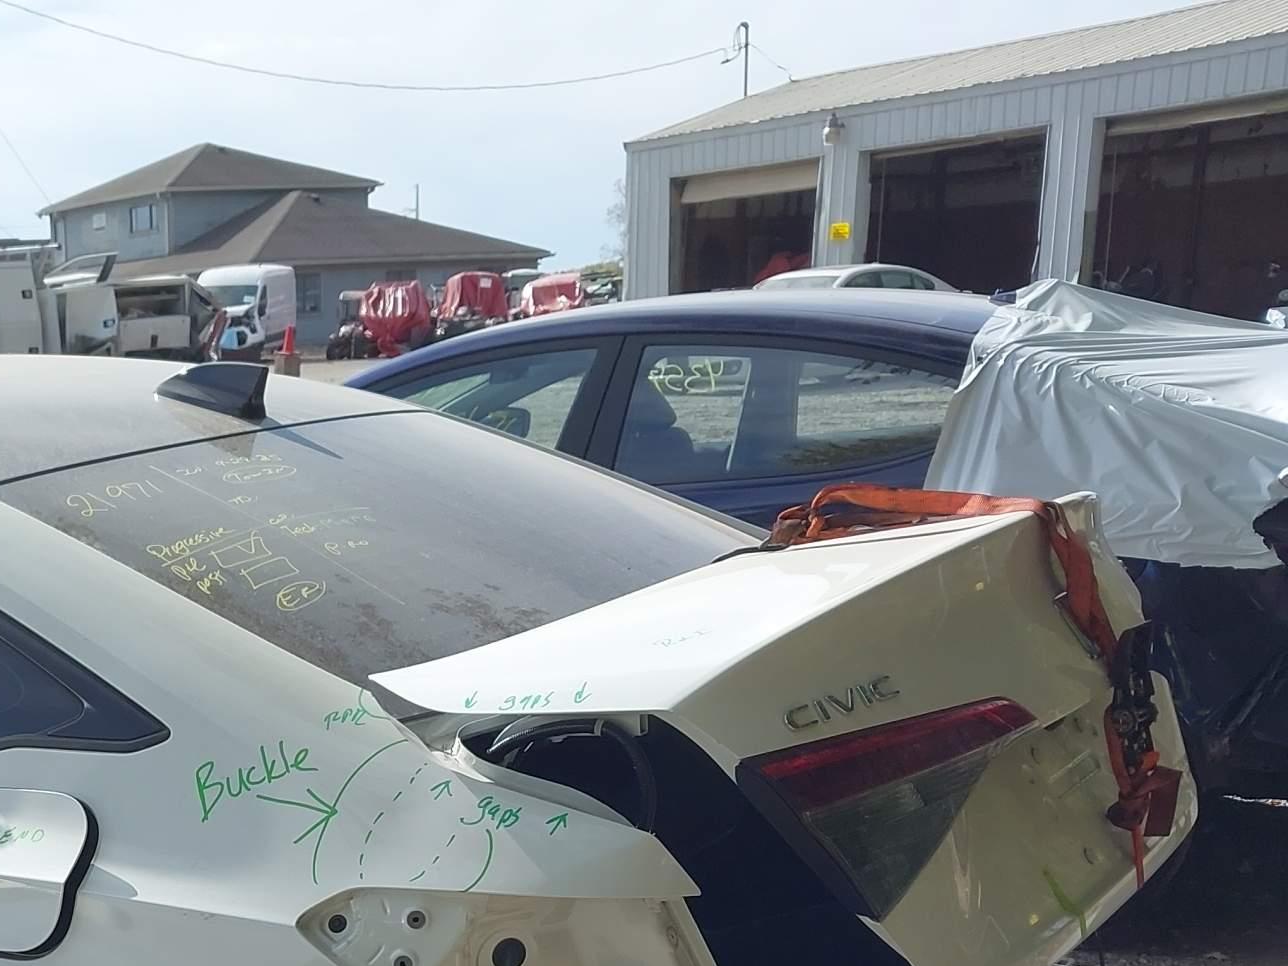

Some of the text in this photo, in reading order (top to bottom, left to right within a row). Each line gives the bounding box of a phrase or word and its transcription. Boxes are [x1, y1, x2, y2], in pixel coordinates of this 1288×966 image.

[66, 479, 164, 517] 21971
[783, 674, 901, 733] CIVIC
[195, 739, 320, 824] Buckle
